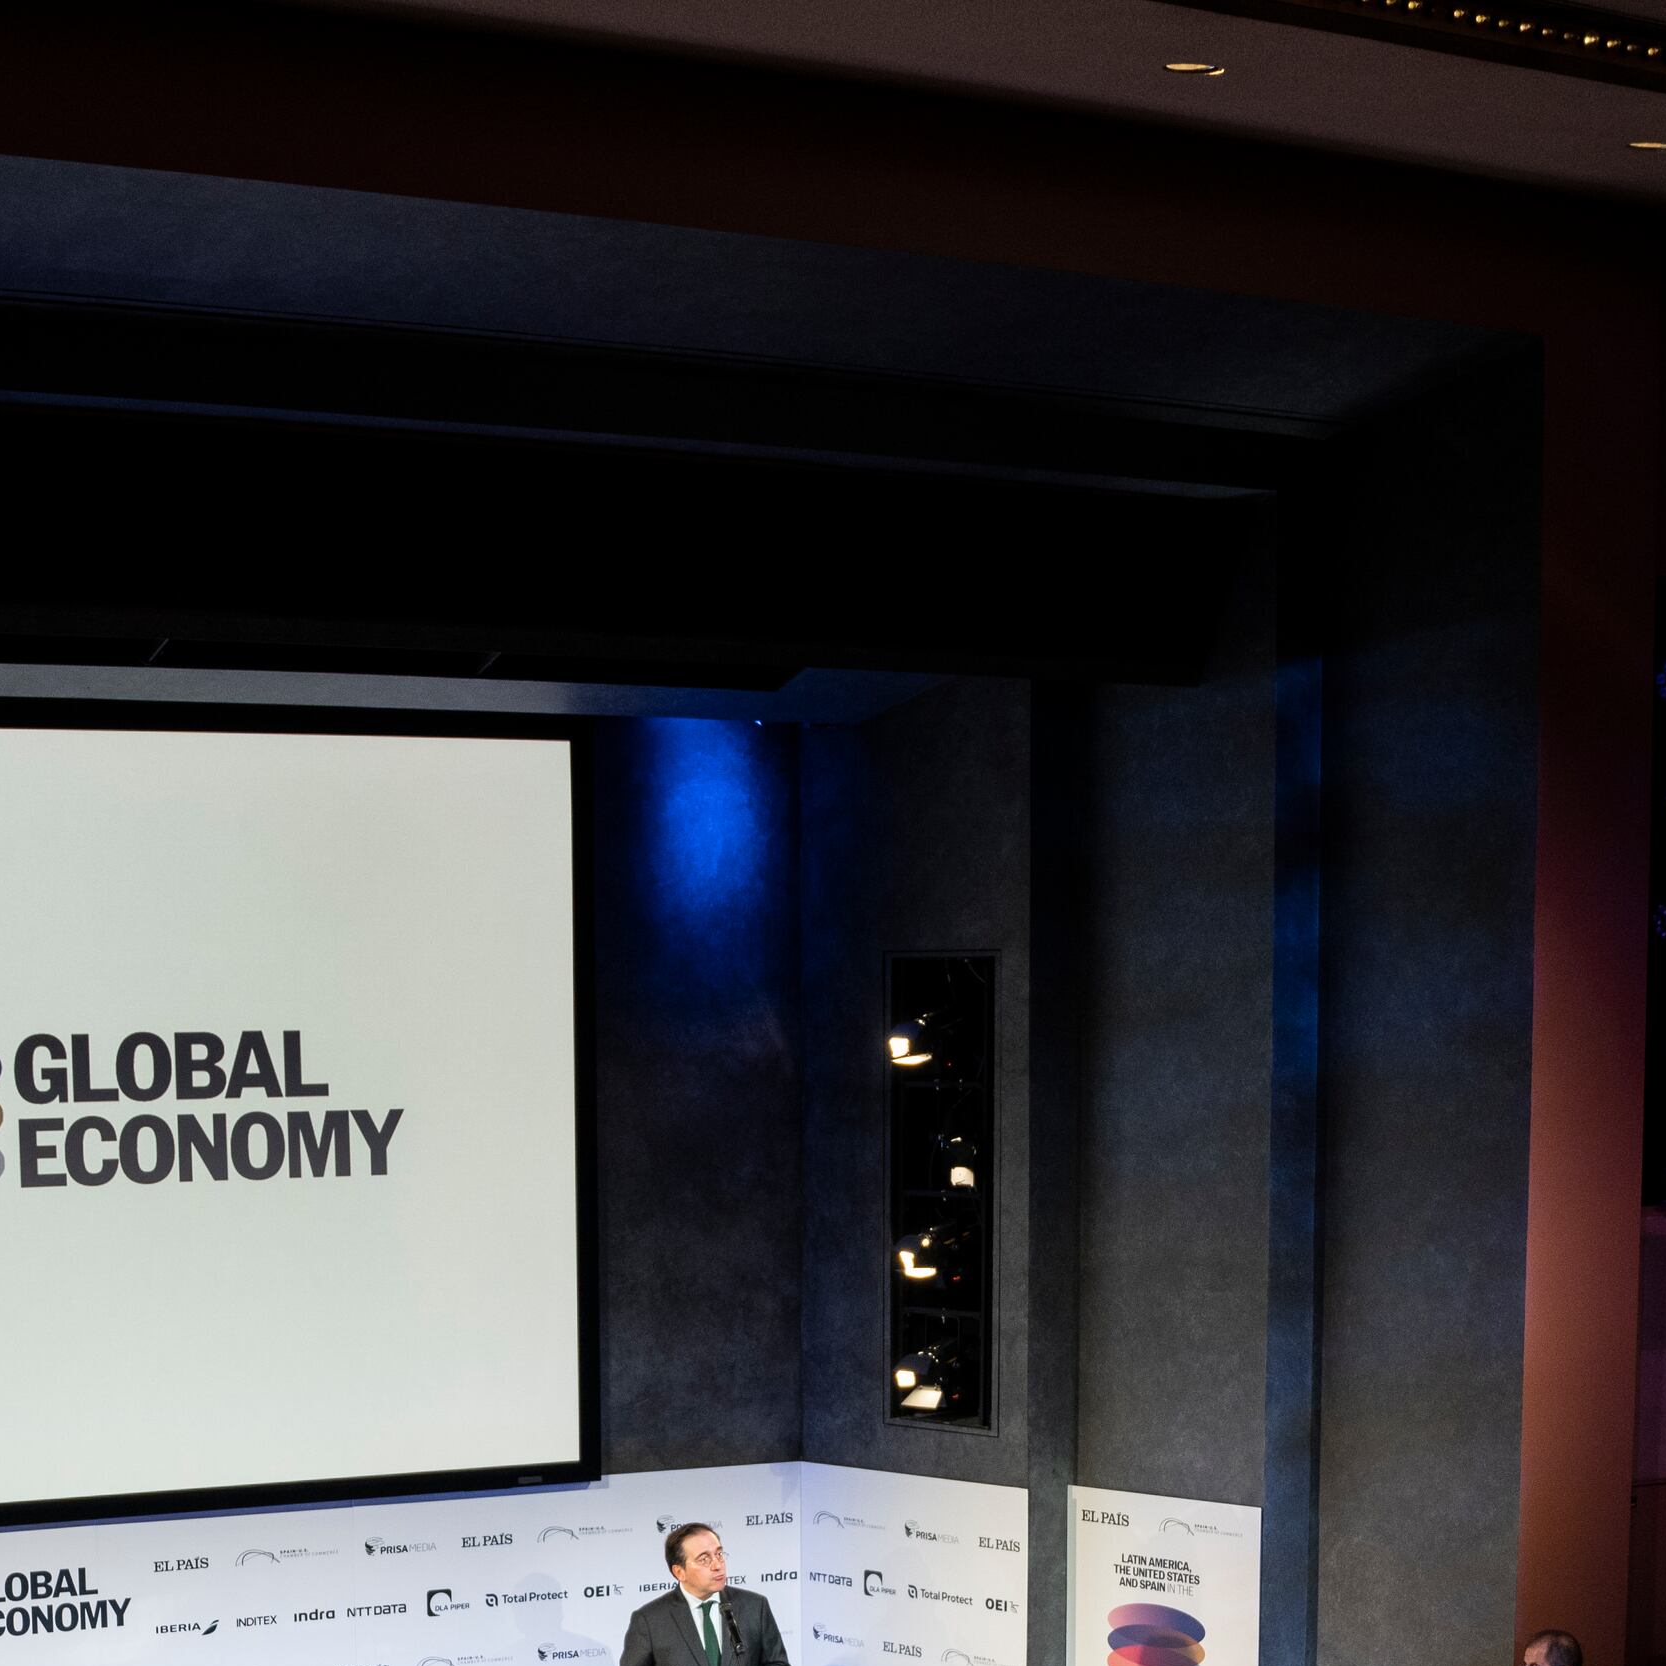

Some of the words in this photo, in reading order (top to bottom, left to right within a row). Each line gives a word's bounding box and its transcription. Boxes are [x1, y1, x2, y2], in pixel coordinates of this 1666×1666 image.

[14, 1030, 329, 1104] GLOBAL
[18, 1108, 405, 1188] ECONOMY
[746, 1515, 763, 1526] EL
[766, 1512, 793, 1524] PAÍS
[1082, 1509, 1099, 1523] EL
[1101, 1511, 1129, 1527] PAÍS
[461, 1536, 481, 1548] EL
[482, 1533, 513, 1546] PAÍS
[979, 1537, 993, 1550] EL
[996, 1538, 1020, 1552] PAÍS
[153, 1561, 174, 1573] EL
[176, 1557, 209, 1570] PAÍS
[1122, 1554, 1147, 1566] LATIN
[1149, 1556, 1191, 1573] AMERICA,
[1114, 1564, 1131, 1576] THE
[1133, 1566, 1165, 1581] UNITED
[1167, 1570, 1200, 1586] STATES
[584, 1586, 610, 1598] OEI
[1119, 1577, 1138, 1589] AND
[1140, 1579, 1165, 1592] SPAIN
[1167, 1582, 1175, 1594] IN
[1177, 1583, 1194, 1596] THE
[502, 1594, 527, 1604] Total
[529, 1590, 568, 1602] Protect
[921, 1588, 940, 1600] Total
[942, 1592, 973, 1606] Protect
[347, 1607, 372, 1618] NTT
[985, 1598, 1007, 1612] OEI
[236, 1615, 277, 1627] INDITEX
[156, 1624, 200, 1634] IBERIA
[883, 1642, 897, 1653] EL
[899, 1643, 922, 1658] PAÍS
